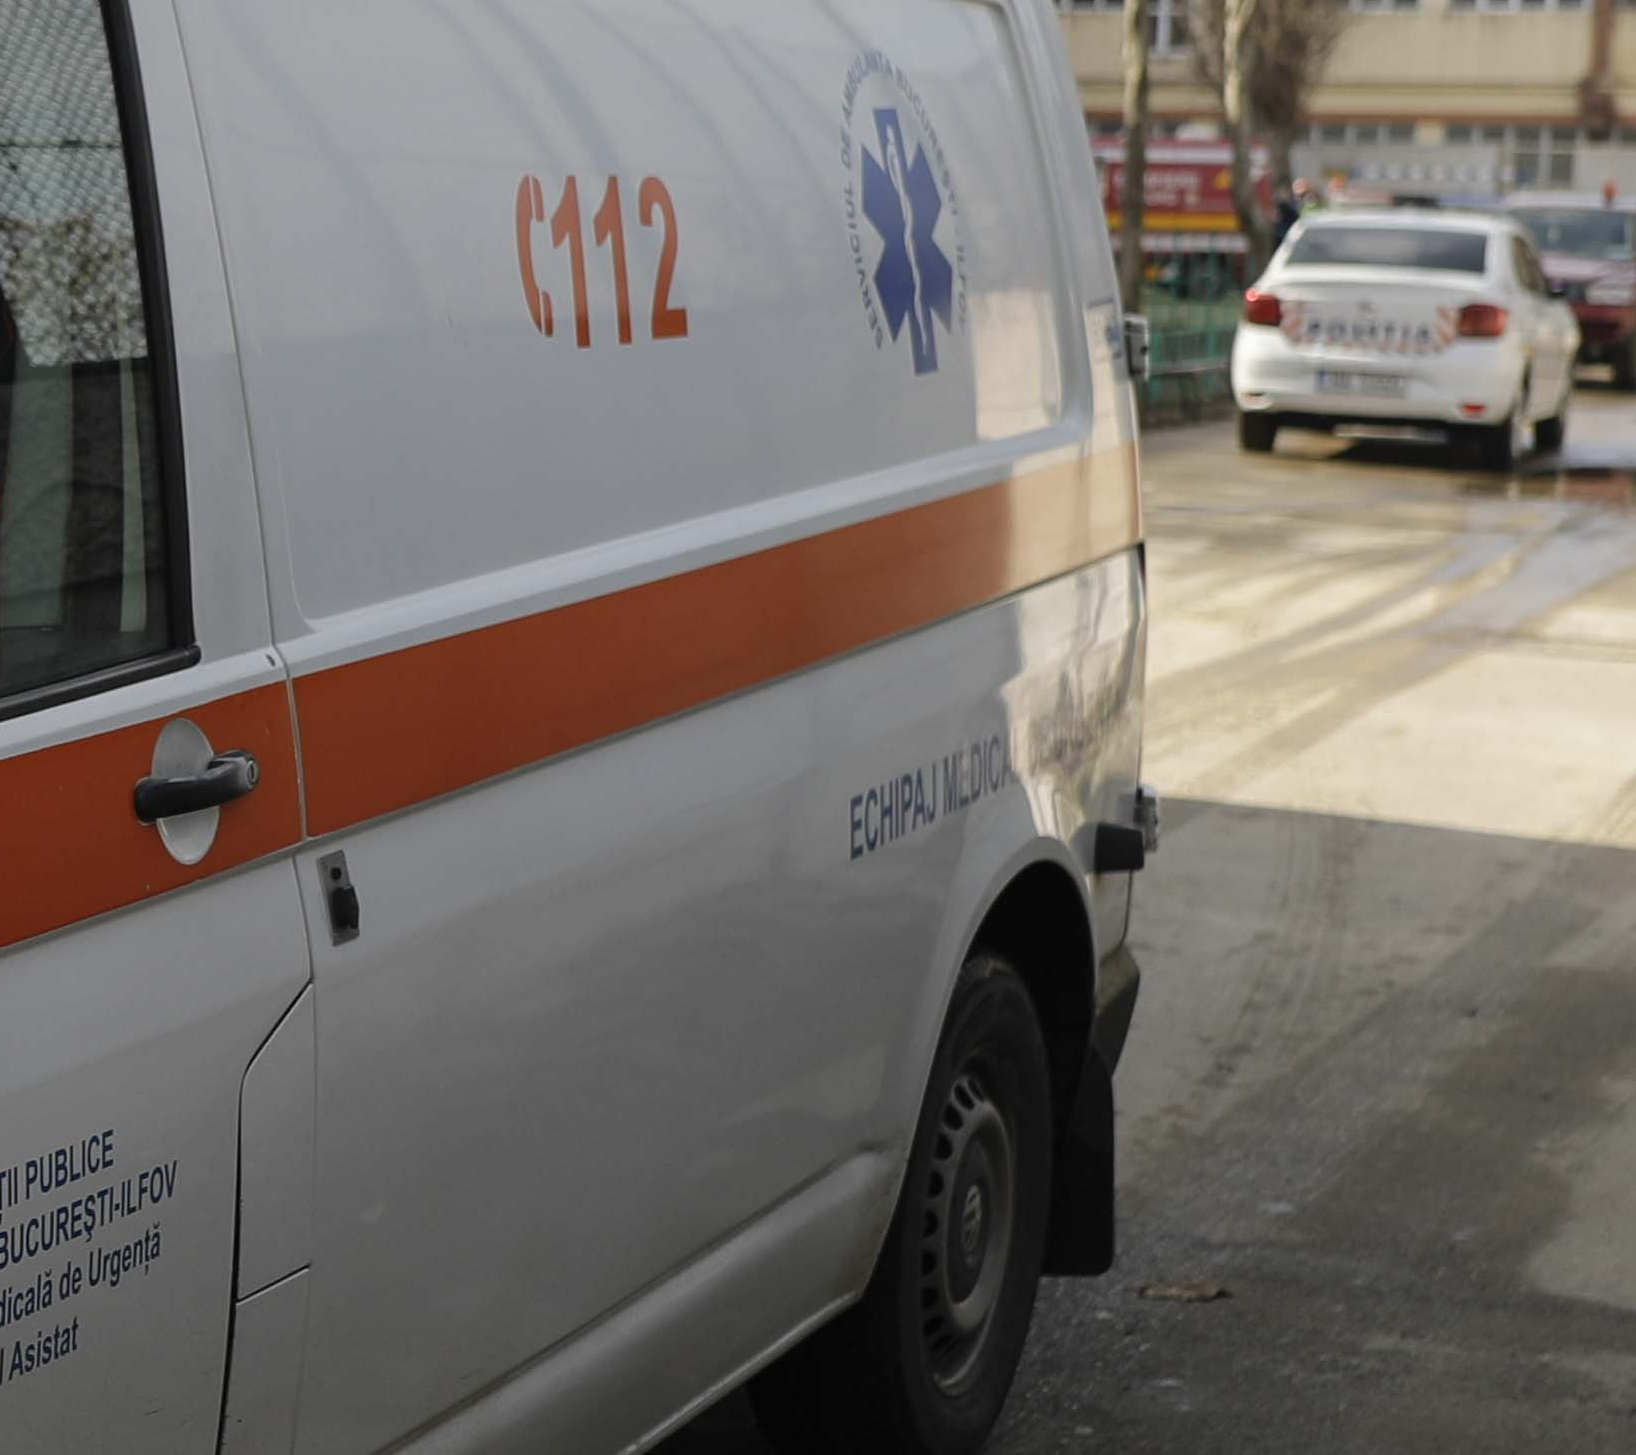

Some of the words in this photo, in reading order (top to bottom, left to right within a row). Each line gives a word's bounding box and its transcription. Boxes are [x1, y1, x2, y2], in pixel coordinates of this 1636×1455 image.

[850, 761, 937, 861] ECHIPAJ
[25, 1128, 115, 1200] PUBLICE
[59, 1260, 82, 1300] de
[9, 1315, 79, 1381] Asistat
